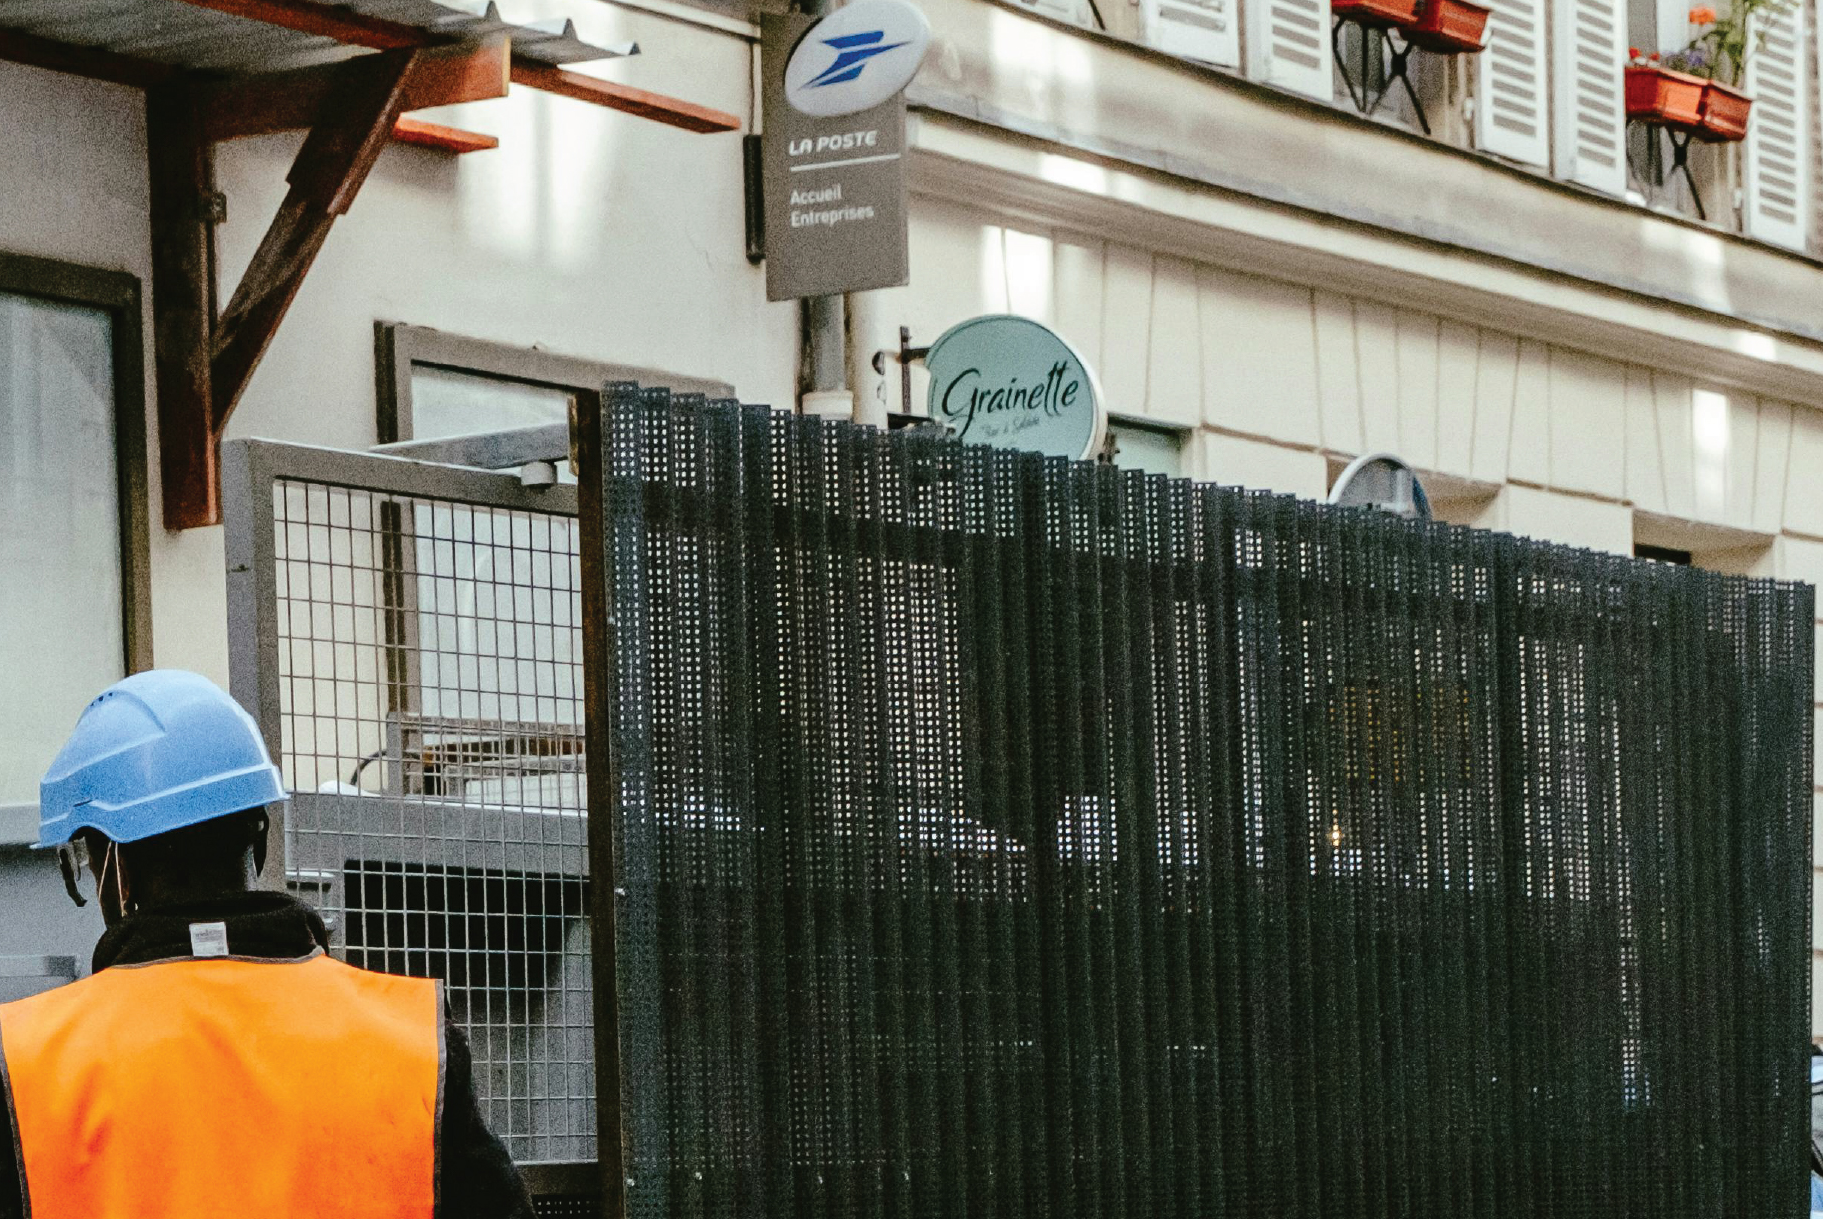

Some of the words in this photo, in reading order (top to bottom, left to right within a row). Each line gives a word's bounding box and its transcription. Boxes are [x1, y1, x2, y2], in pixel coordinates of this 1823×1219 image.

[788, 139, 812, 157] LA
[816, 130, 878, 153] POSTE
[789, 184, 842, 206] Accueil
[790, 205, 875, 229] Entreprises
[941, 360, 1079, 438] Grainette
